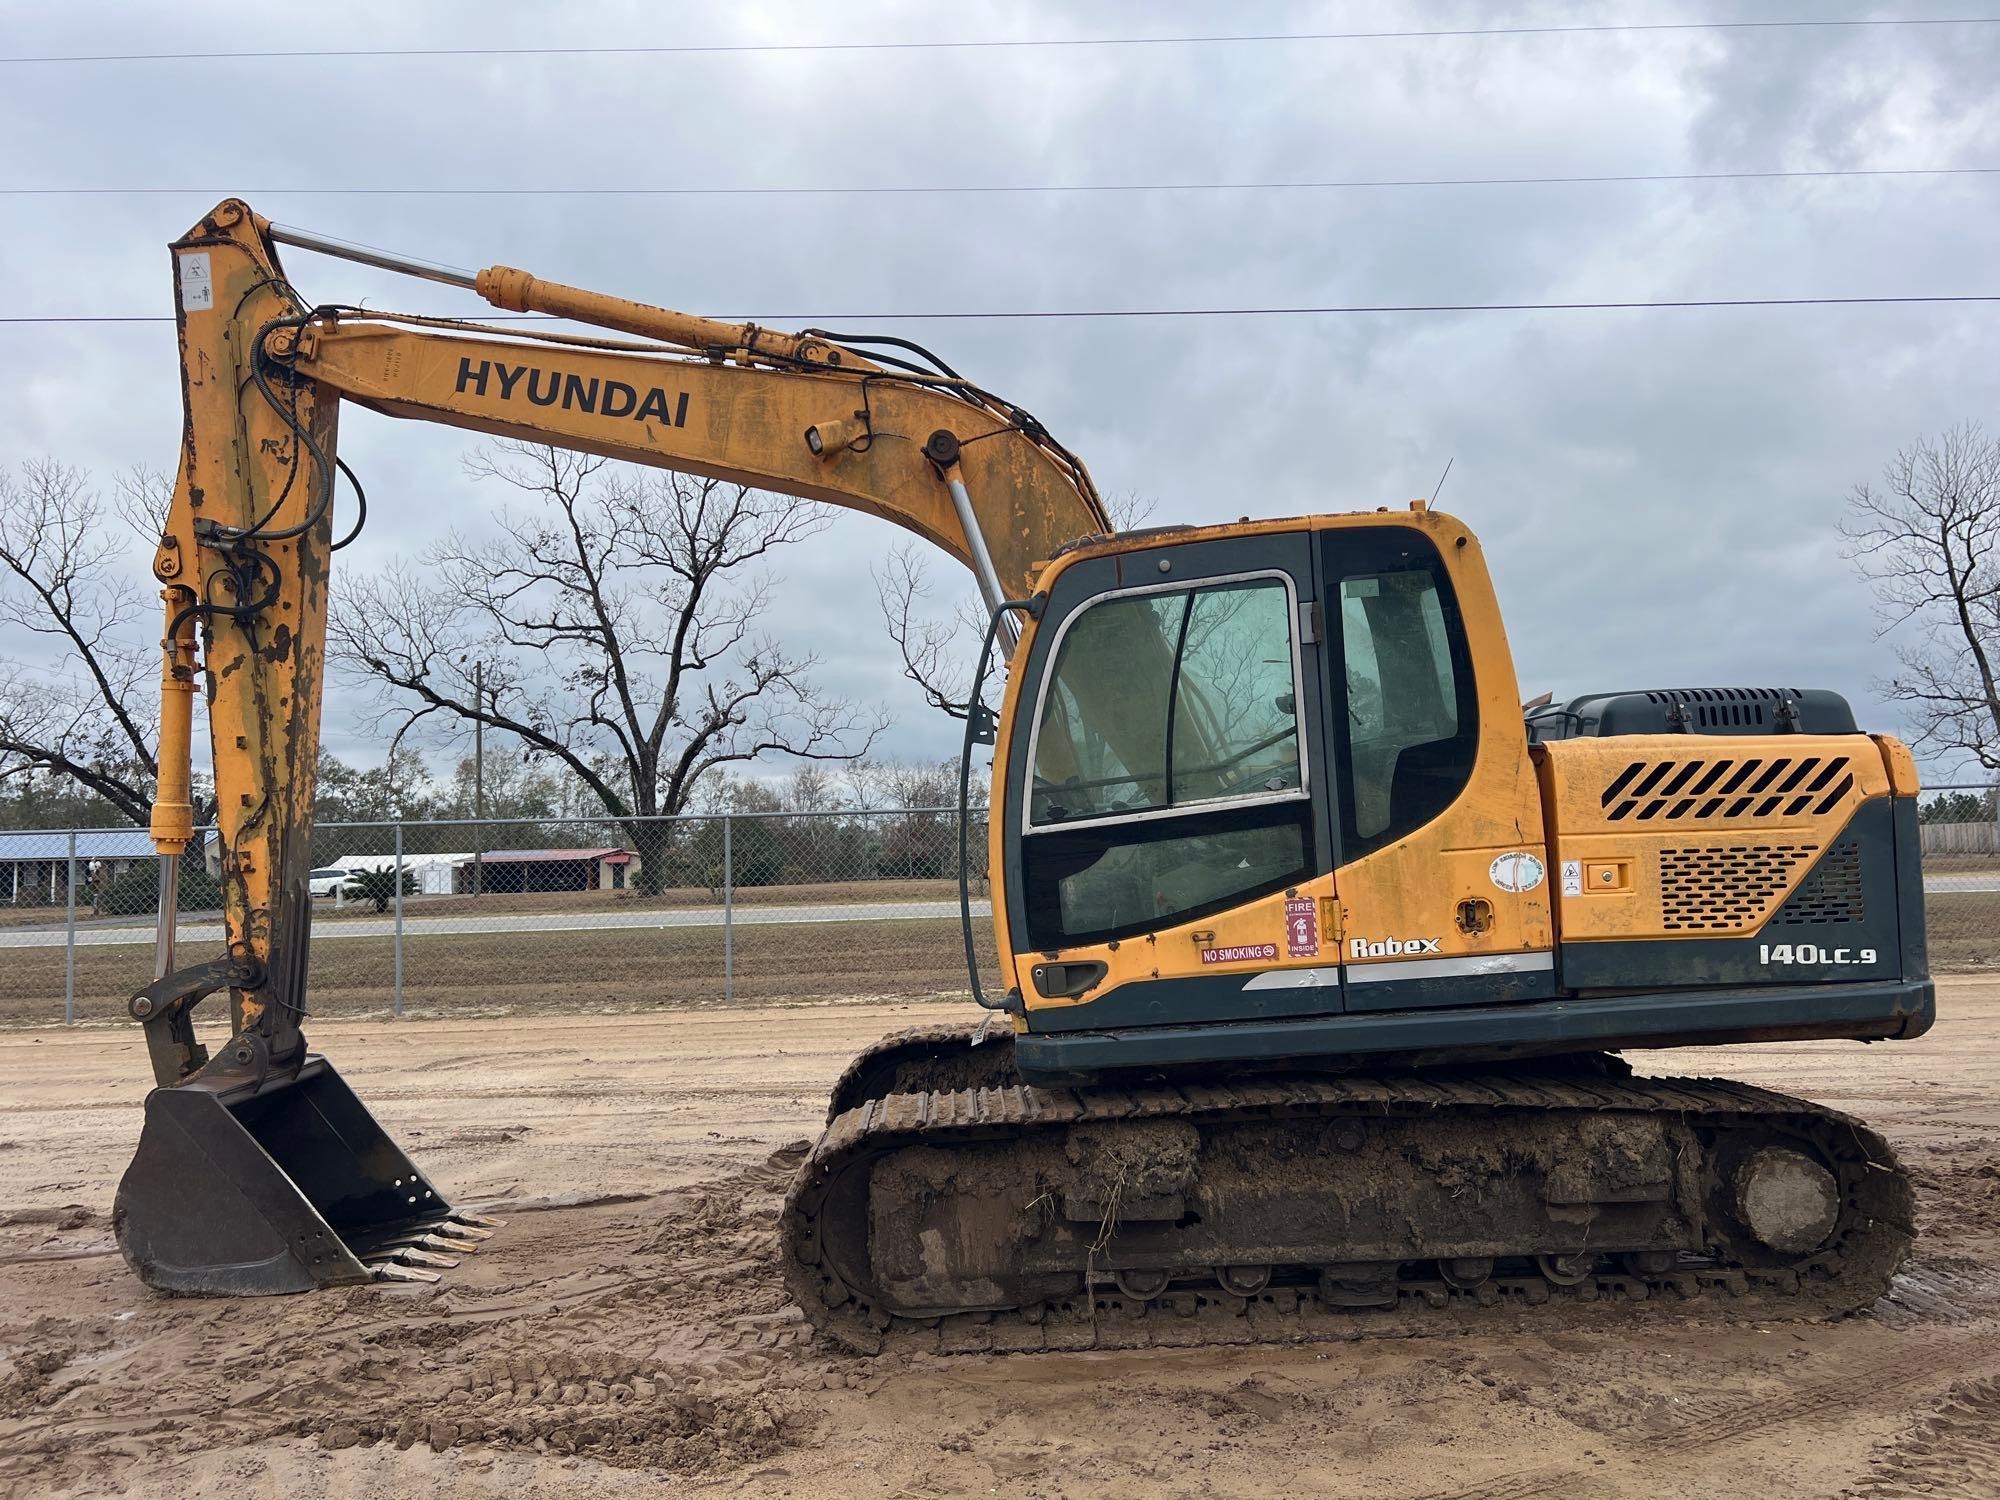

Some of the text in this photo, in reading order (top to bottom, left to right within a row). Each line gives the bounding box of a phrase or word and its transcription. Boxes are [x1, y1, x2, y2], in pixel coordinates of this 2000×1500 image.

[455, 357, 690, 428] HYUNDAI
[1288, 902, 1312, 912] FIRE
[1203, 946, 1262, 962] NO SMOKING
[1291, 944, 1315, 952] INSIDE
[1350, 936, 1442, 958] Robex
